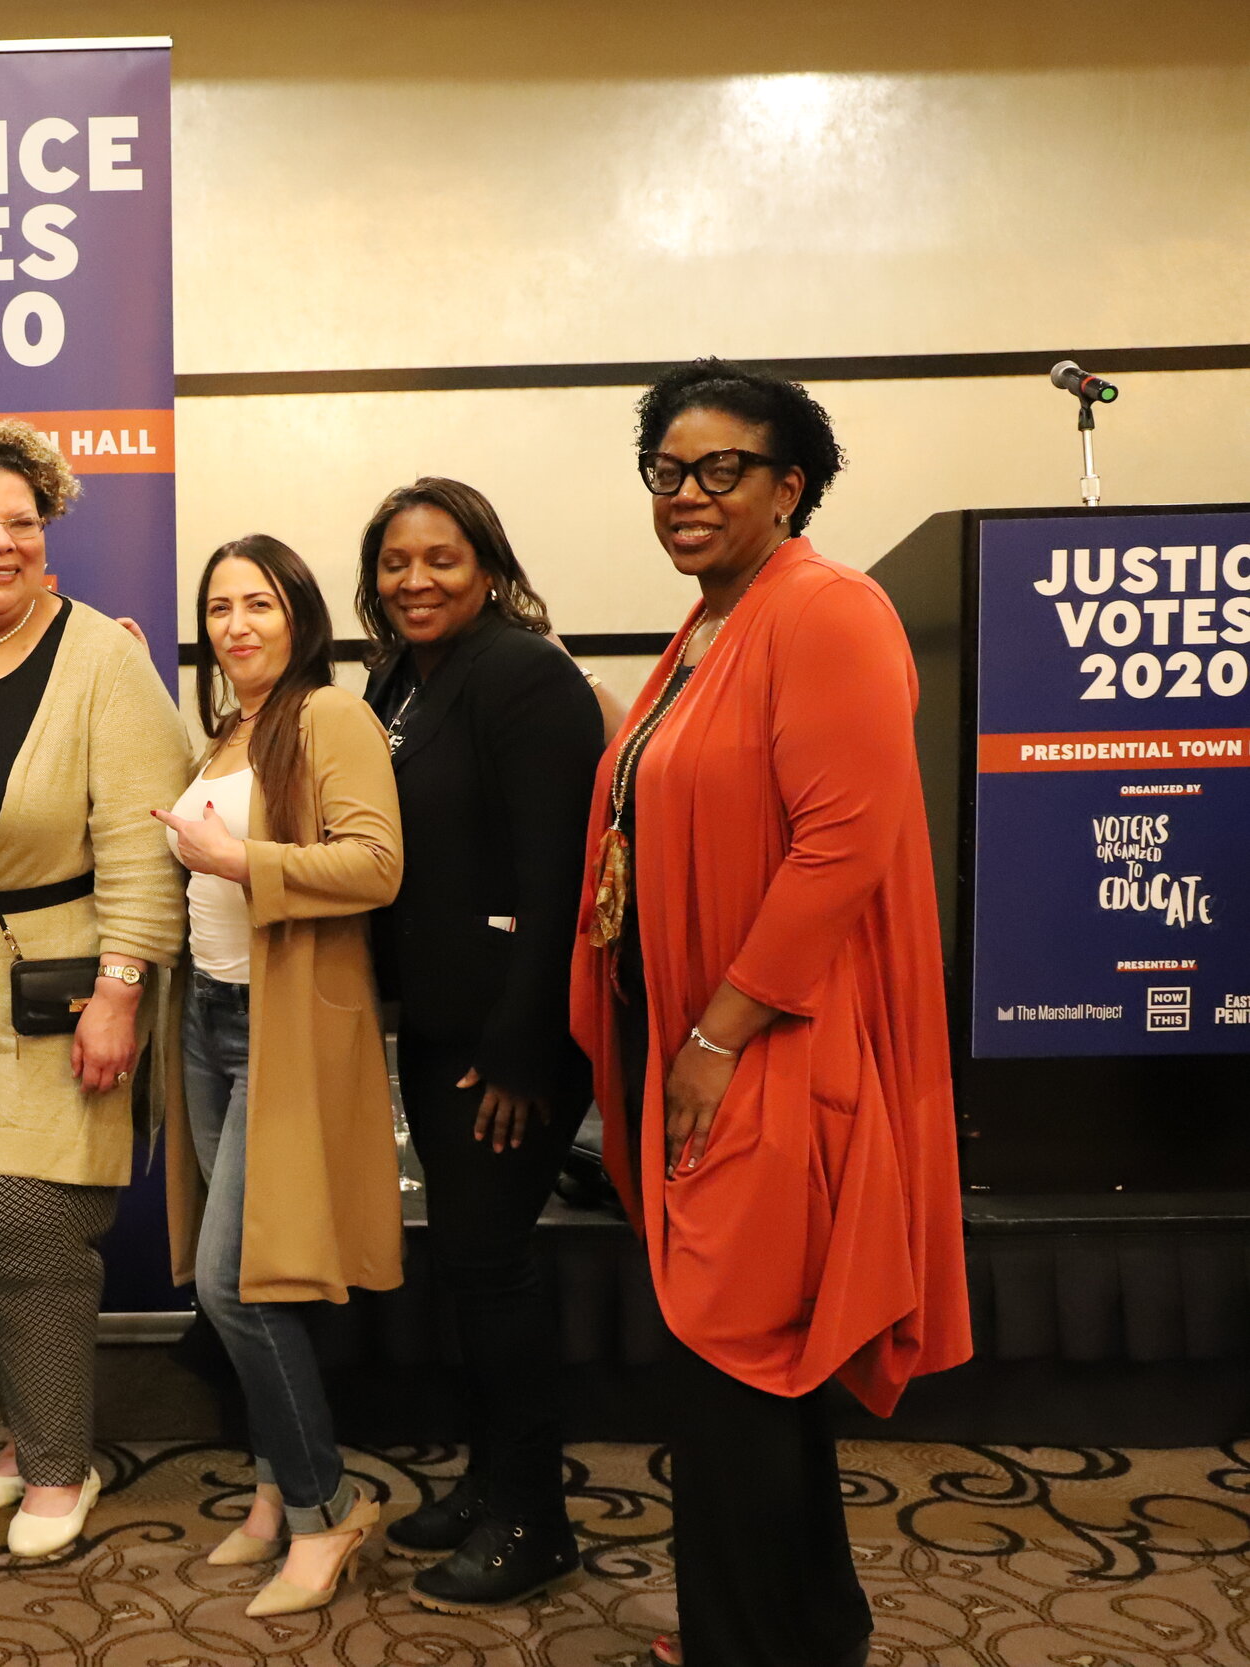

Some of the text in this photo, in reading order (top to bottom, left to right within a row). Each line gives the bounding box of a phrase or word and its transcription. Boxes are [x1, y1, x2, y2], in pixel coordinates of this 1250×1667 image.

[71, 429, 156, 456] HALL
[1033, 543, 1250, 596] JUSTIC
[1054, 596, 1250, 648] VOTES
[1079, 650, 1248, 700] 2020
[1020, 739, 1242, 761] PRESIDENTIAL TOWN
[1120, 784, 1201, 795] ORGANIZED BY
[1092, 814, 1169, 848] VOTERS
[1096, 841, 1162, 864] ORGANIZED
[1126, 860, 1143, 883] TO
[1098, 873, 1213, 929] EDUCATE
[1117, 959, 1196, 970] PRESENTED BY
[1154, 993, 1184, 1003] NOW
[1017, 1003, 1123, 1021] The Marshall Project
[1153, 1015, 1183, 1026] THIS
